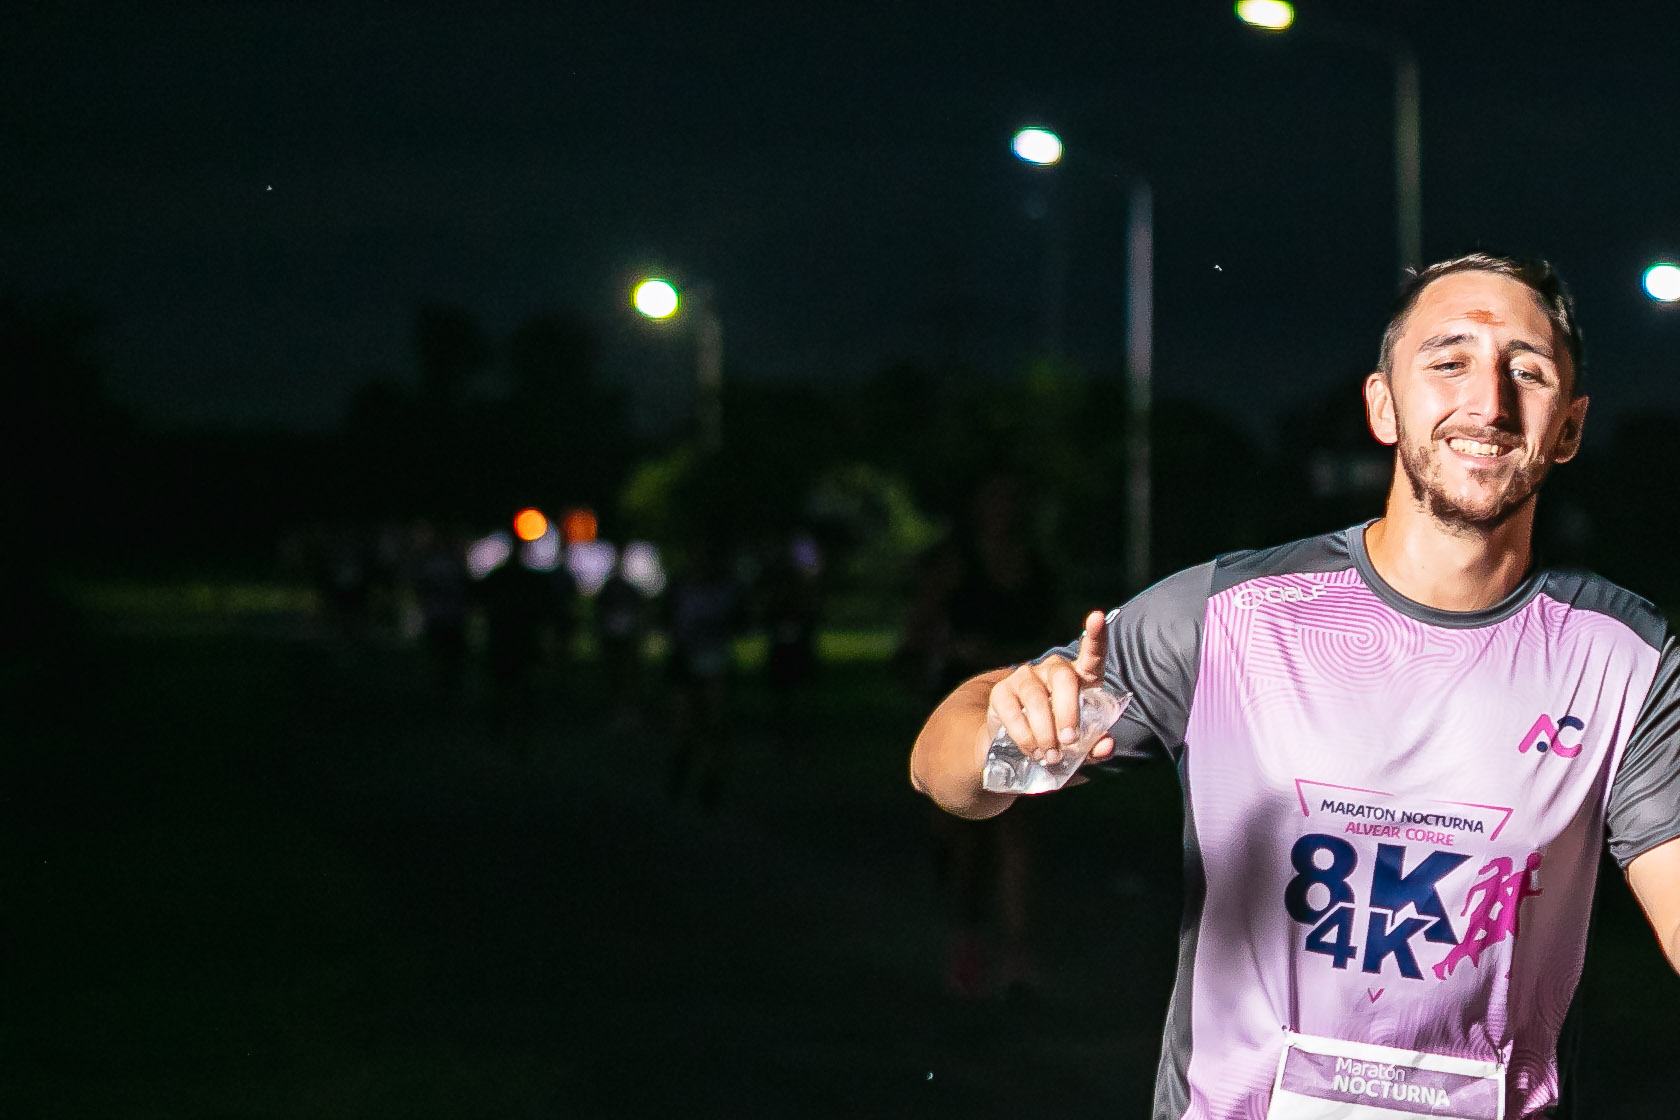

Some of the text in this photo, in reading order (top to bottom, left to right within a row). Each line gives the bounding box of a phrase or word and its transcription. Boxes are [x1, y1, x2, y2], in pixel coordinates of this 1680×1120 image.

[1518, 713, 1585, 758] AC
[1320, 799, 1485, 834] MARATON NOCTURNA
[1344, 821, 1455, 847] ALVEAR CORRE
[1284, 833, 1474, 945] 8K
[1305, 906, 1425, 980] 4K
[1335, 1056, 1406, 1081] Maratón
[1333, 1074, 1451, 1108] NOCTURNA
